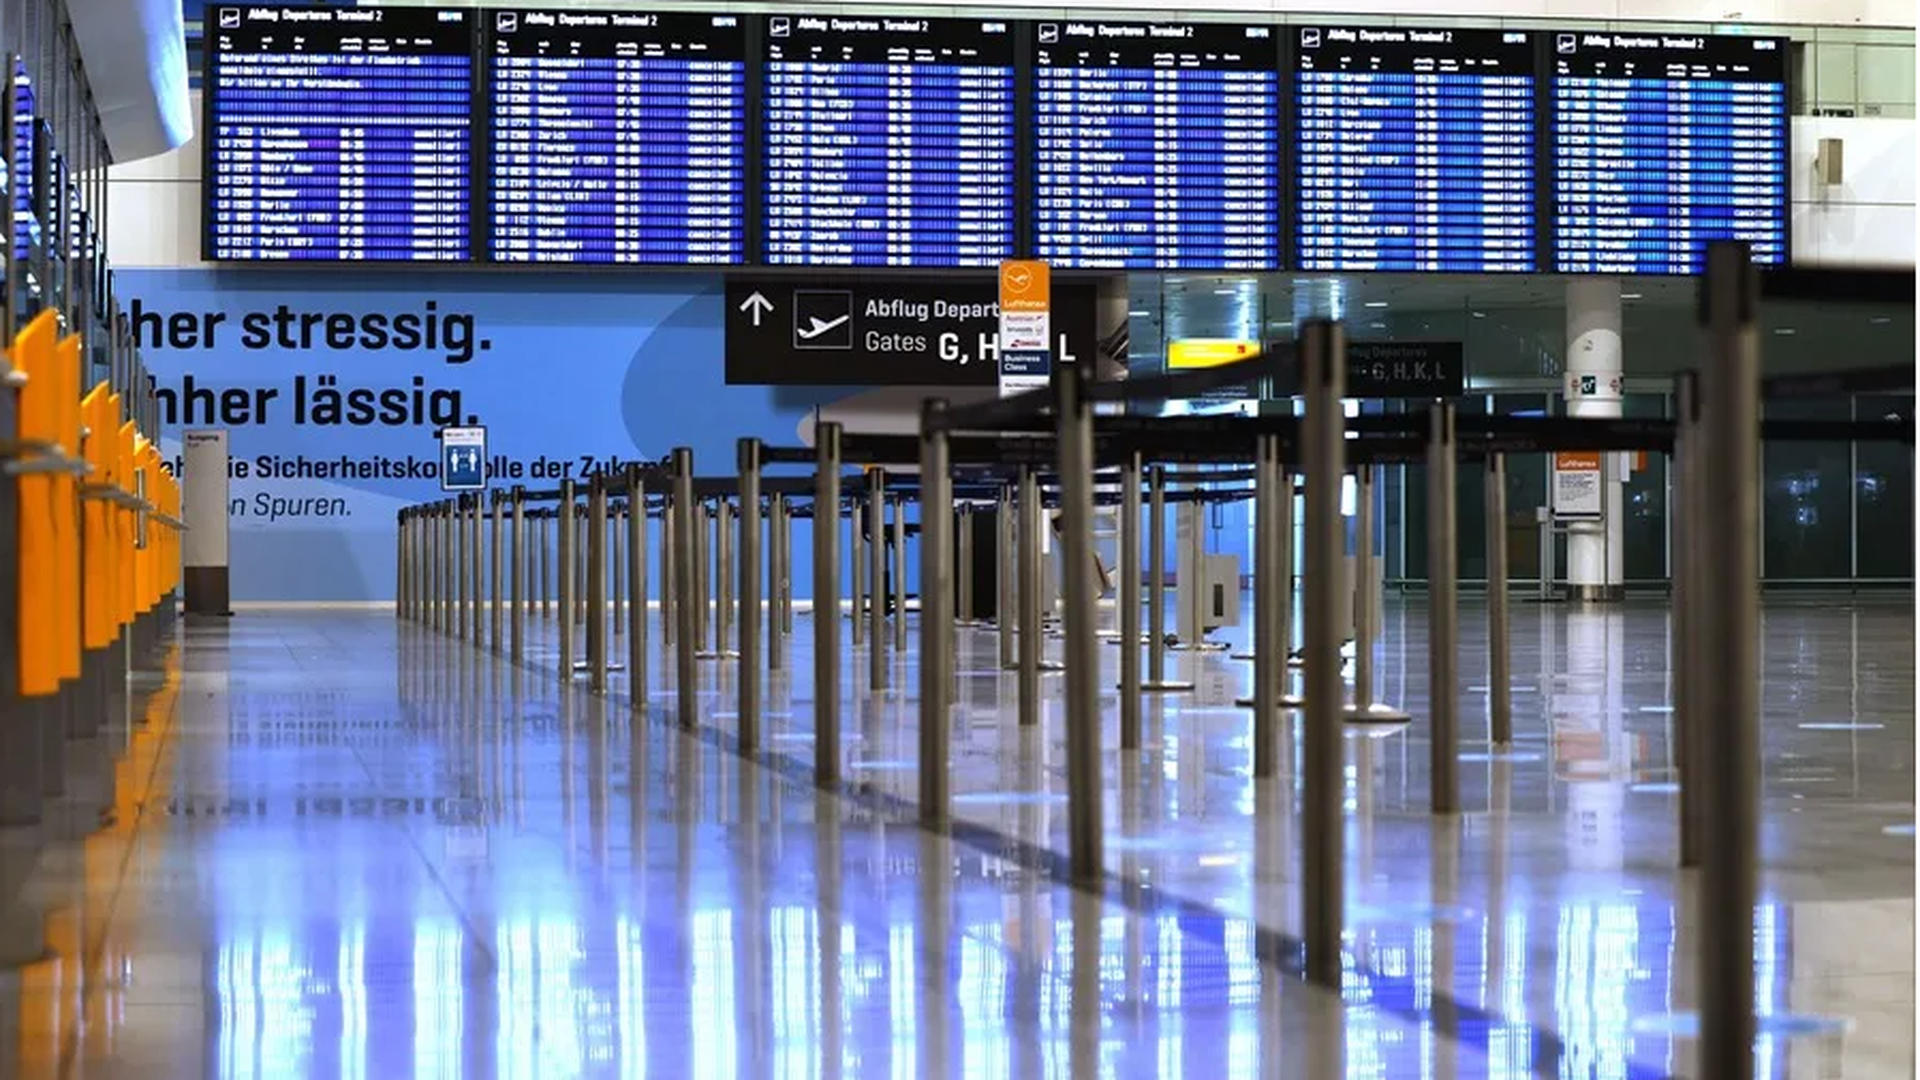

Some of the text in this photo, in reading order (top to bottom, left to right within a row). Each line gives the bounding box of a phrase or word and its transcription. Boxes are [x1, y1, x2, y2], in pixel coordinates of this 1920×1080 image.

[248, 9, 382, 22] Abflug Departures Terminal 2
[525, 14, 658, 26] Abflug Departures Terminal 2
[798, 19, 928, 32] Abflug Departures Terminal 2
[1066, 24, 1194, 38] Abflug Departures Terminal 2
[1328, 30, 1452, 42] Abflug Departures Terminal 2
[1583, 36, 1704, 49] Abflug Departures Terminal 2
[1003, 299, 1047, 308] Lufthansa
[865, 299, 1000, 322] Abflug Depart
[241, 301, 492, 363] stressig.
[865, 331, 1076, 364] Gates G, H L
[1004, 354, 1041, 363] Business
[1004, 363, 1028, 371] Class
[294, 375, 479, 438] lässig.
[530, 455, 574, 478] der
[253, 493, 352, 521] Spuren.
